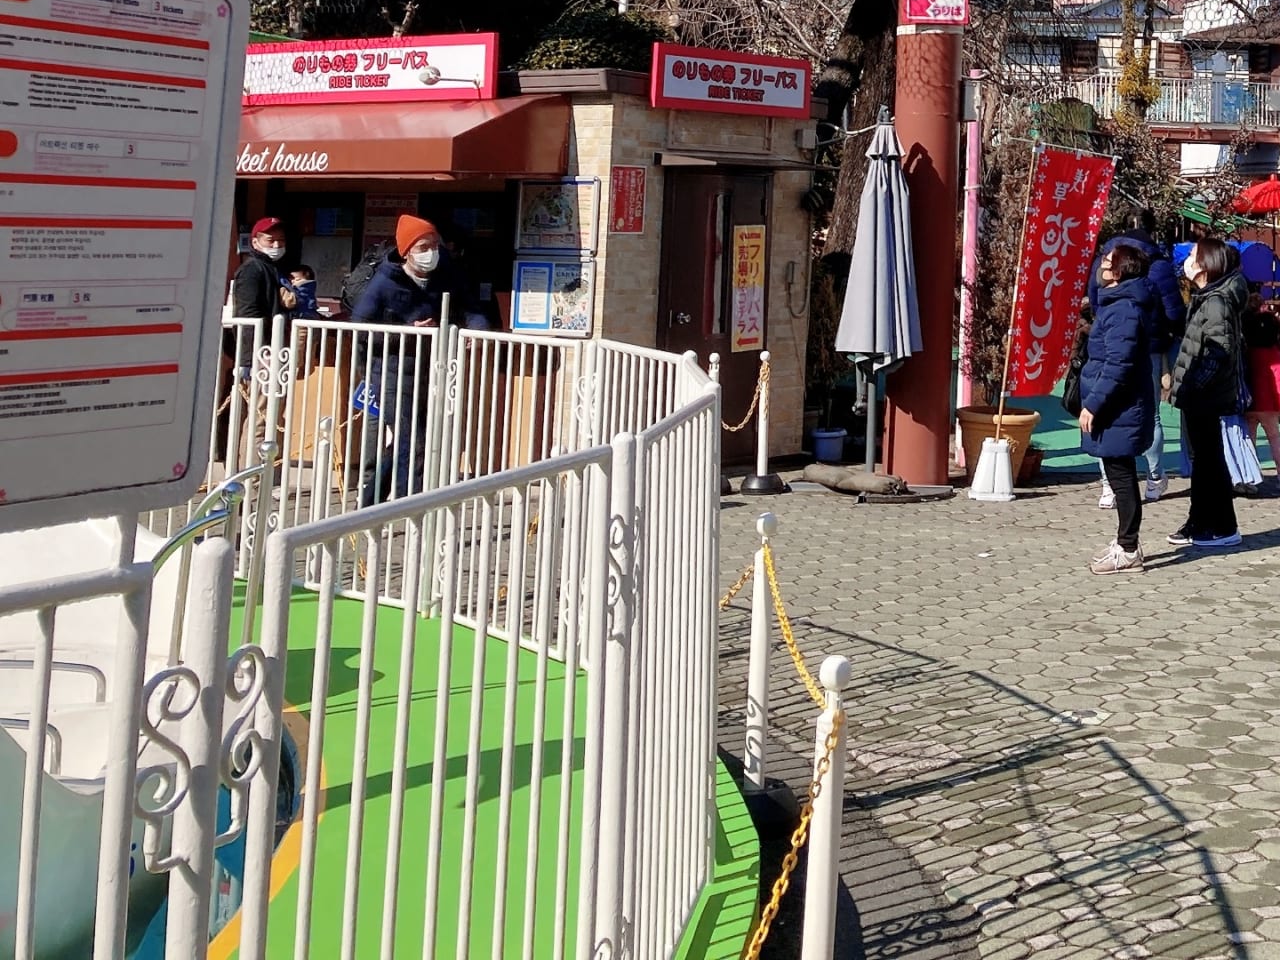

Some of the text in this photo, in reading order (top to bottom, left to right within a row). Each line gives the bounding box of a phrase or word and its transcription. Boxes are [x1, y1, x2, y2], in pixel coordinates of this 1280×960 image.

[154, 1, 161, 11] 3
[292, 50, 429, 74] のりもの券 フリーパス
[329, 73, 391, 89] RIDE TICKET
[672, 60, 798, 90] のりもの券 フリーパス
[708, 84, 765, 102] RIDE TICKET
[127, 143, 135, 155] 3
[270, 143, 329, 172] house
[1052, 168, 1090, 208] 浅草
[73, 293, 81, 304] 3
[737, 245, 748, 334] 売場はコチラ
[748, 244, 761, 333] フリーパス
